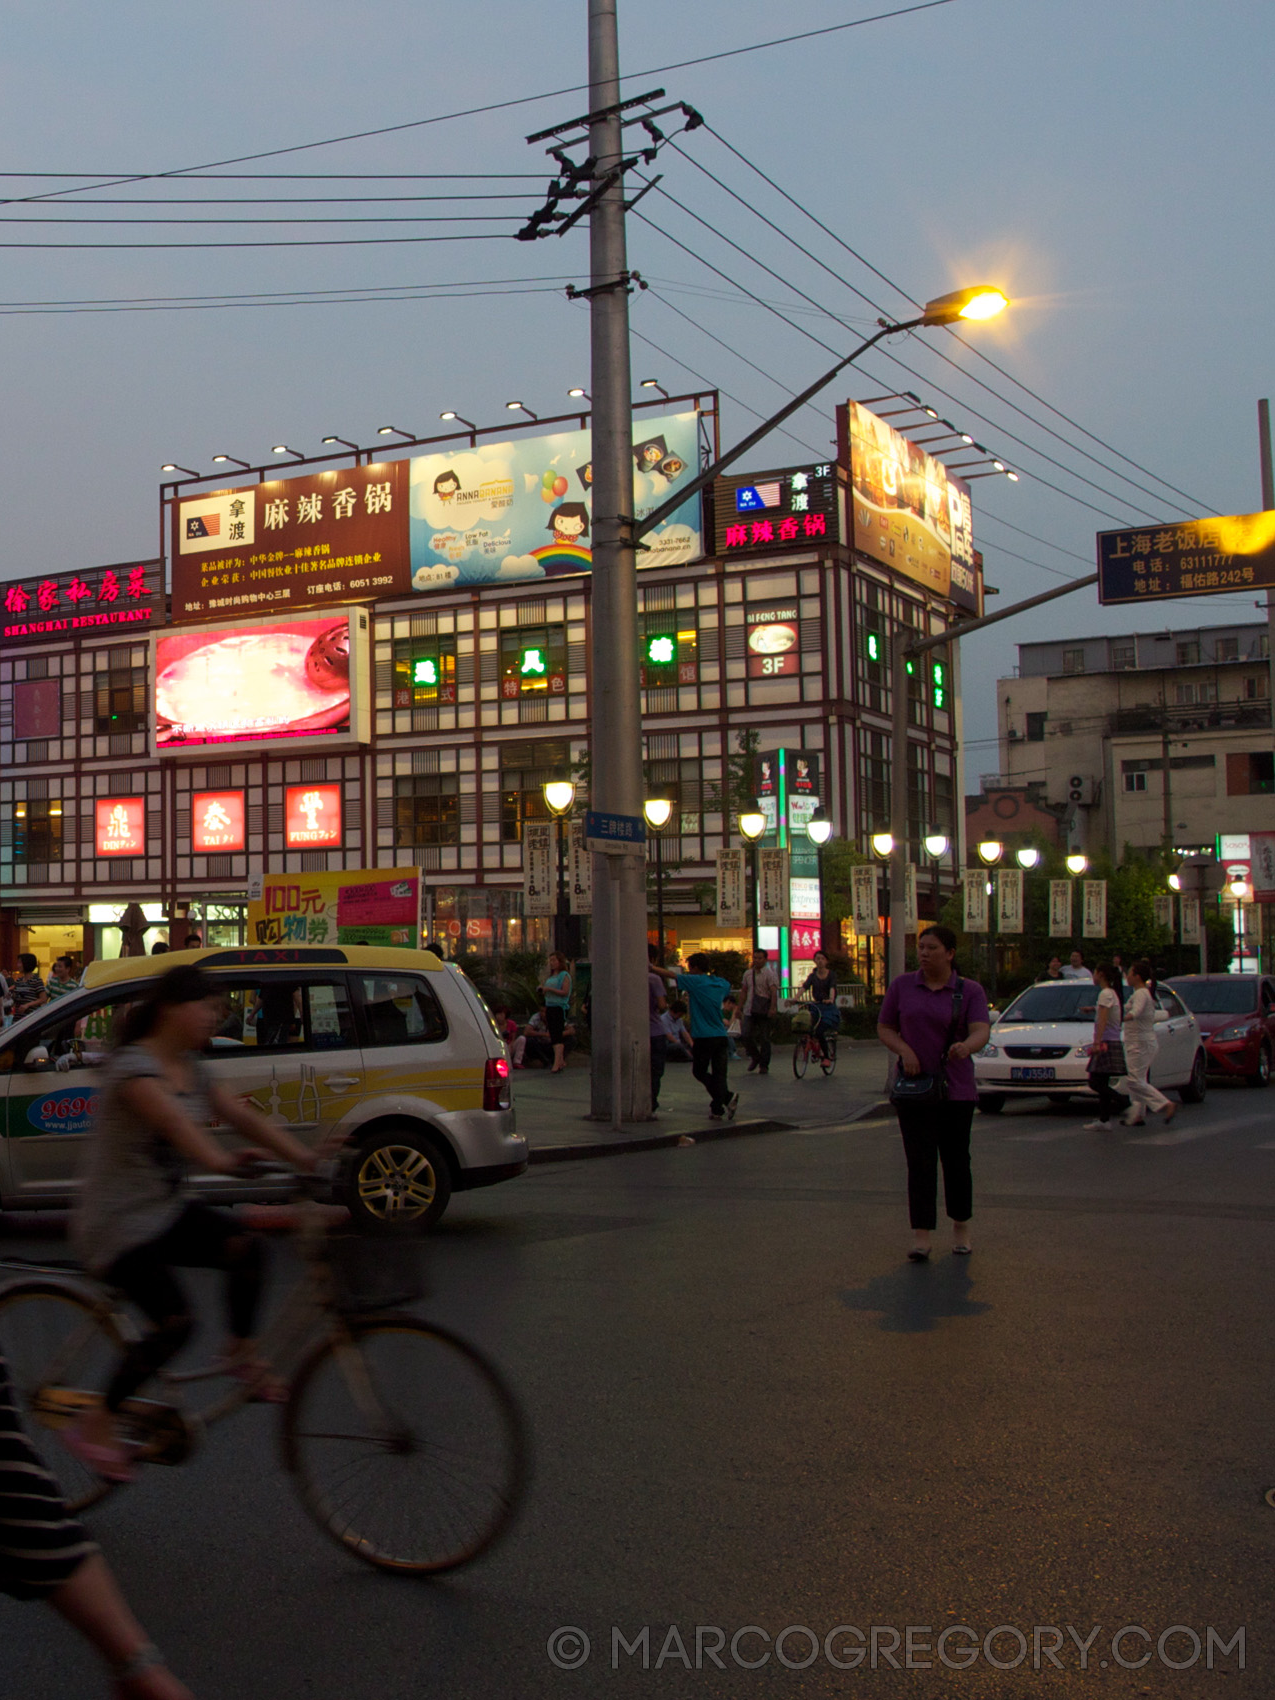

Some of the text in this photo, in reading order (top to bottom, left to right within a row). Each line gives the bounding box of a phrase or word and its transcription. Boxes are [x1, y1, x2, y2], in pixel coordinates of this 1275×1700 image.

[815, 466, 830, 477] 3F
[229, 499, 245, 540] 拿渡
[264, 481, 393, 531] 麻辣香锅
[726, 513, 826, 547] 麻辣香锅
[1109, 529, 1219, 559] 上海老饭店
[4, 566, 153, 613] 徐家私房菜
[4, 608, 152, 637] SHANGHAI RESTAURANT
[762, 657, 784, 674] 3F
[103, 840, 119, 851] DIN
[203, 835, 220, 846] TAI
[265, 884, 326, 916] 100元
[236, 950, 300, 962] TAXI
